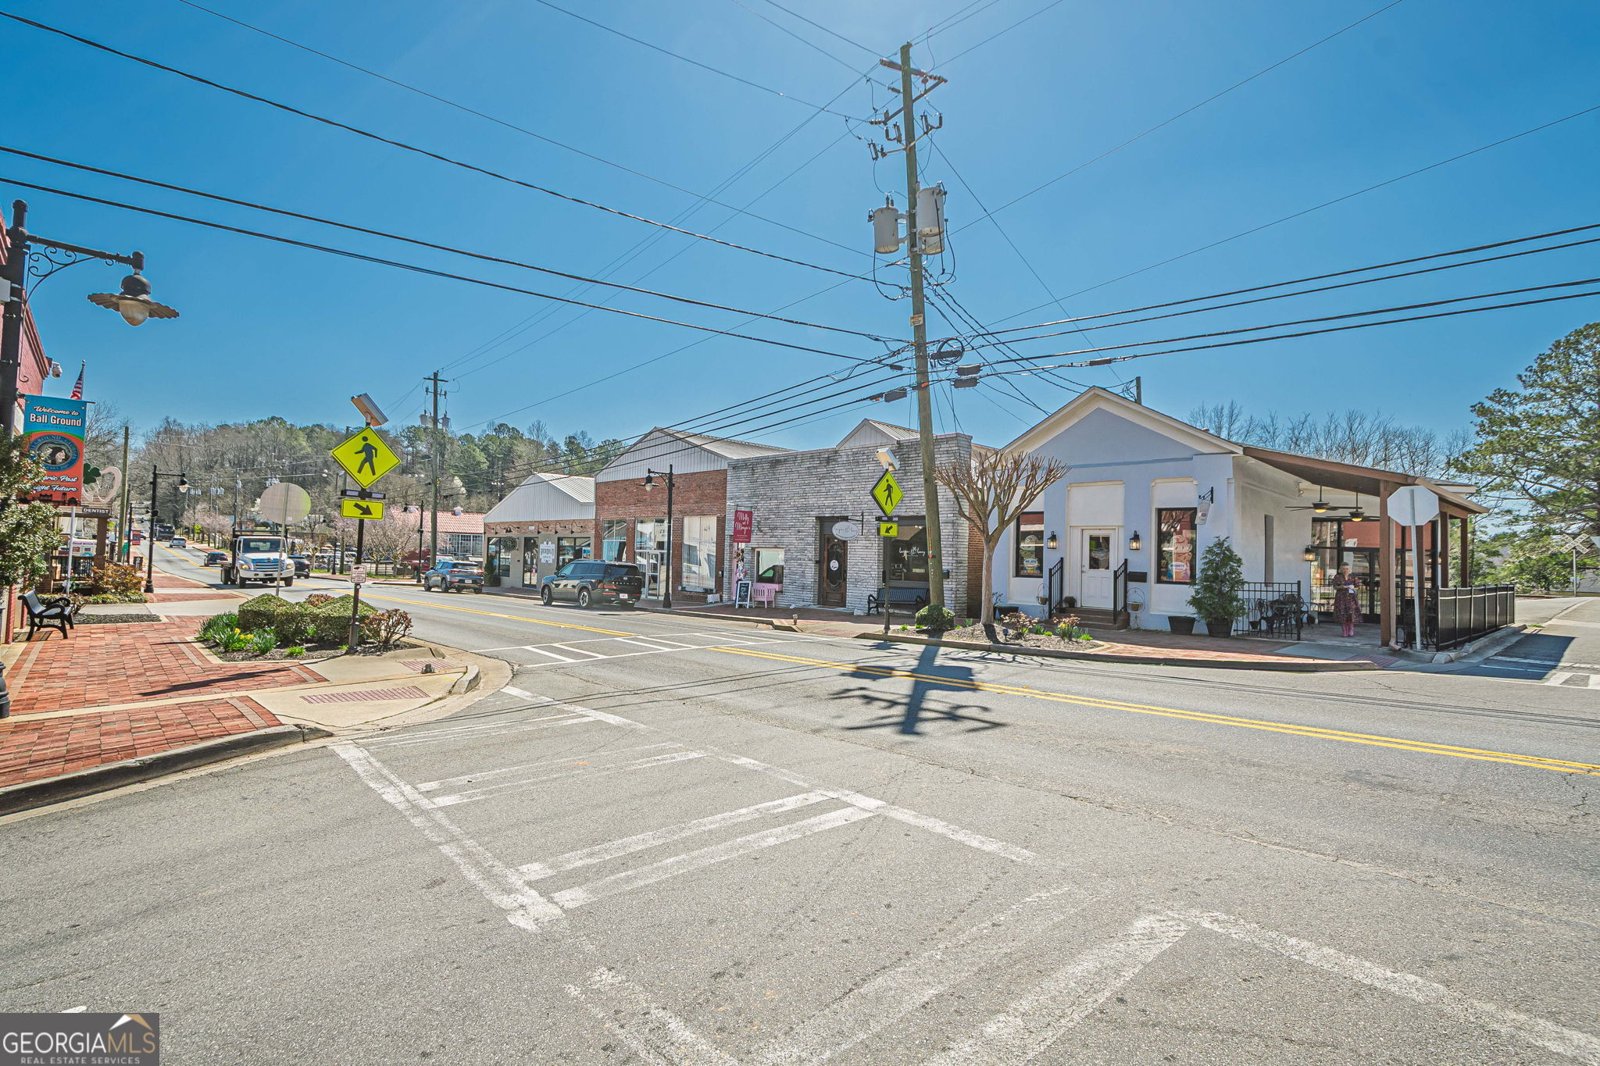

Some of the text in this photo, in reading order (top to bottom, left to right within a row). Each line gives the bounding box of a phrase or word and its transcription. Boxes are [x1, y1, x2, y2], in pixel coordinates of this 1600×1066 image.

[34, 406, 70, 415] Welcome
[30, 413, 82, 426] Ball Ground
